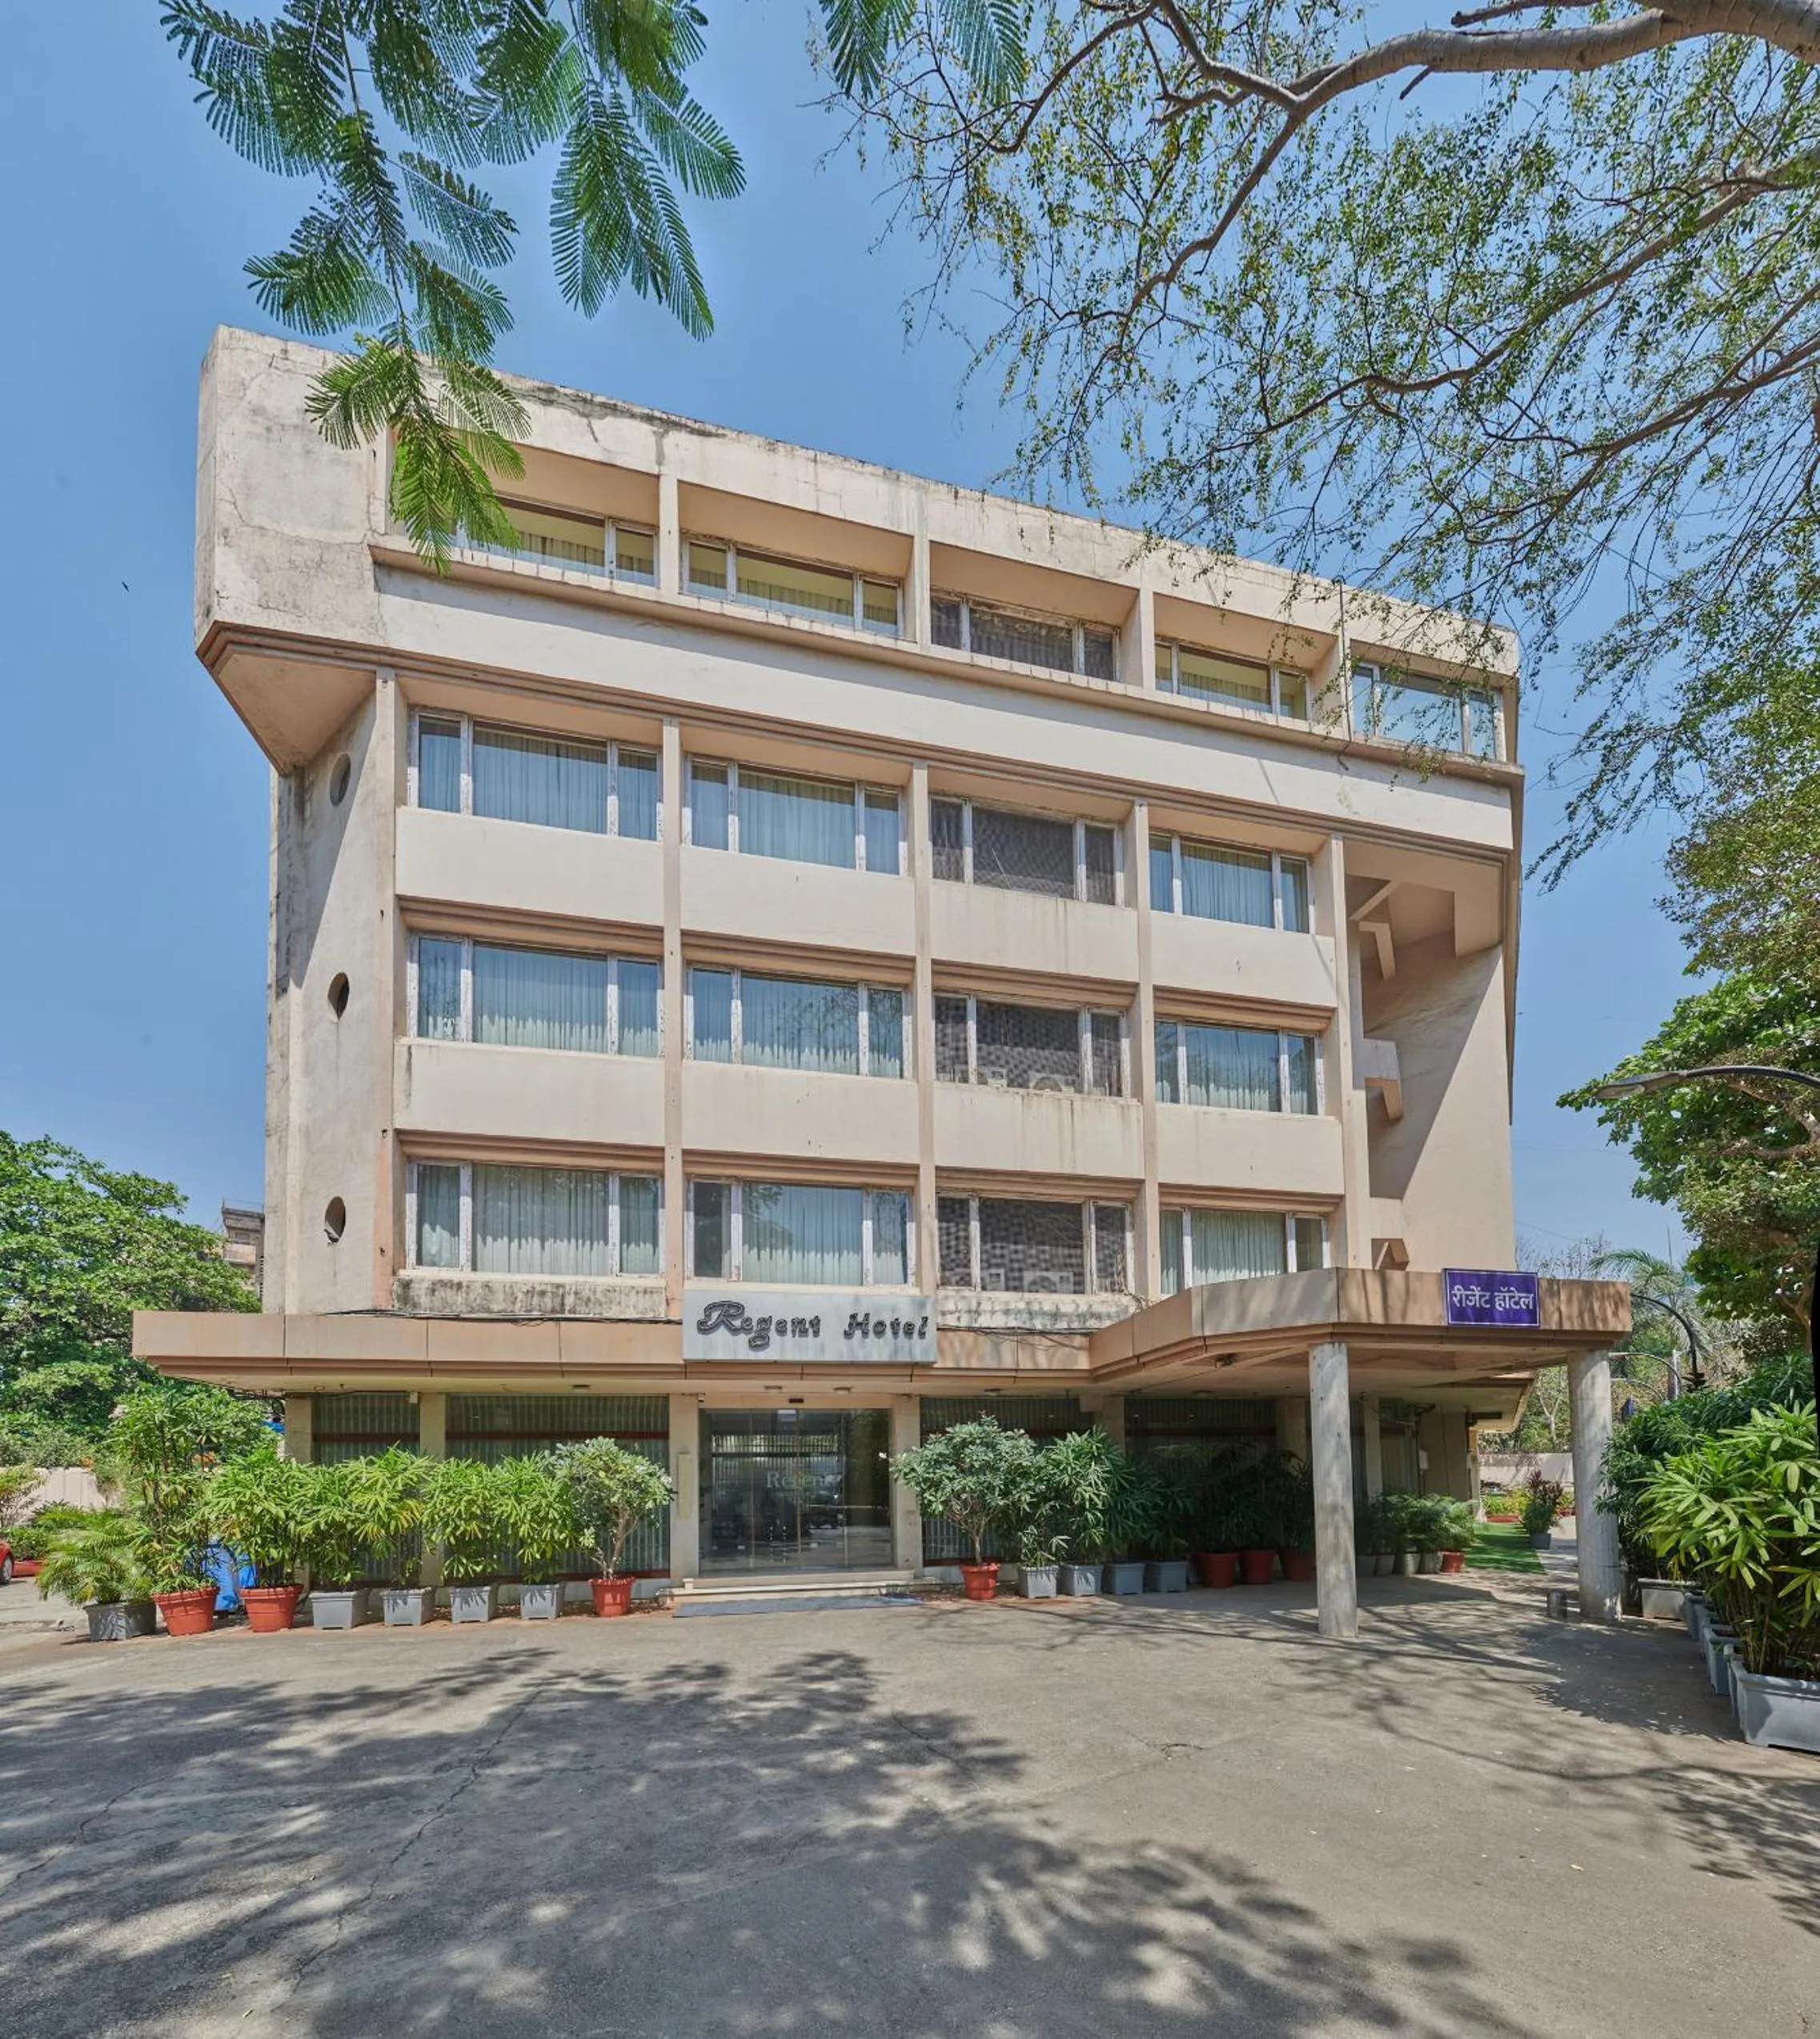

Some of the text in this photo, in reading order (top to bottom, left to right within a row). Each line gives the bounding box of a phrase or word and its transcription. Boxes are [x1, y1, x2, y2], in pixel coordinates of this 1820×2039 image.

[1451, 1284, 1534, 1310] रीजेंट हॉटेल
[697, 1300, 929, 1351] Regent Hotel
